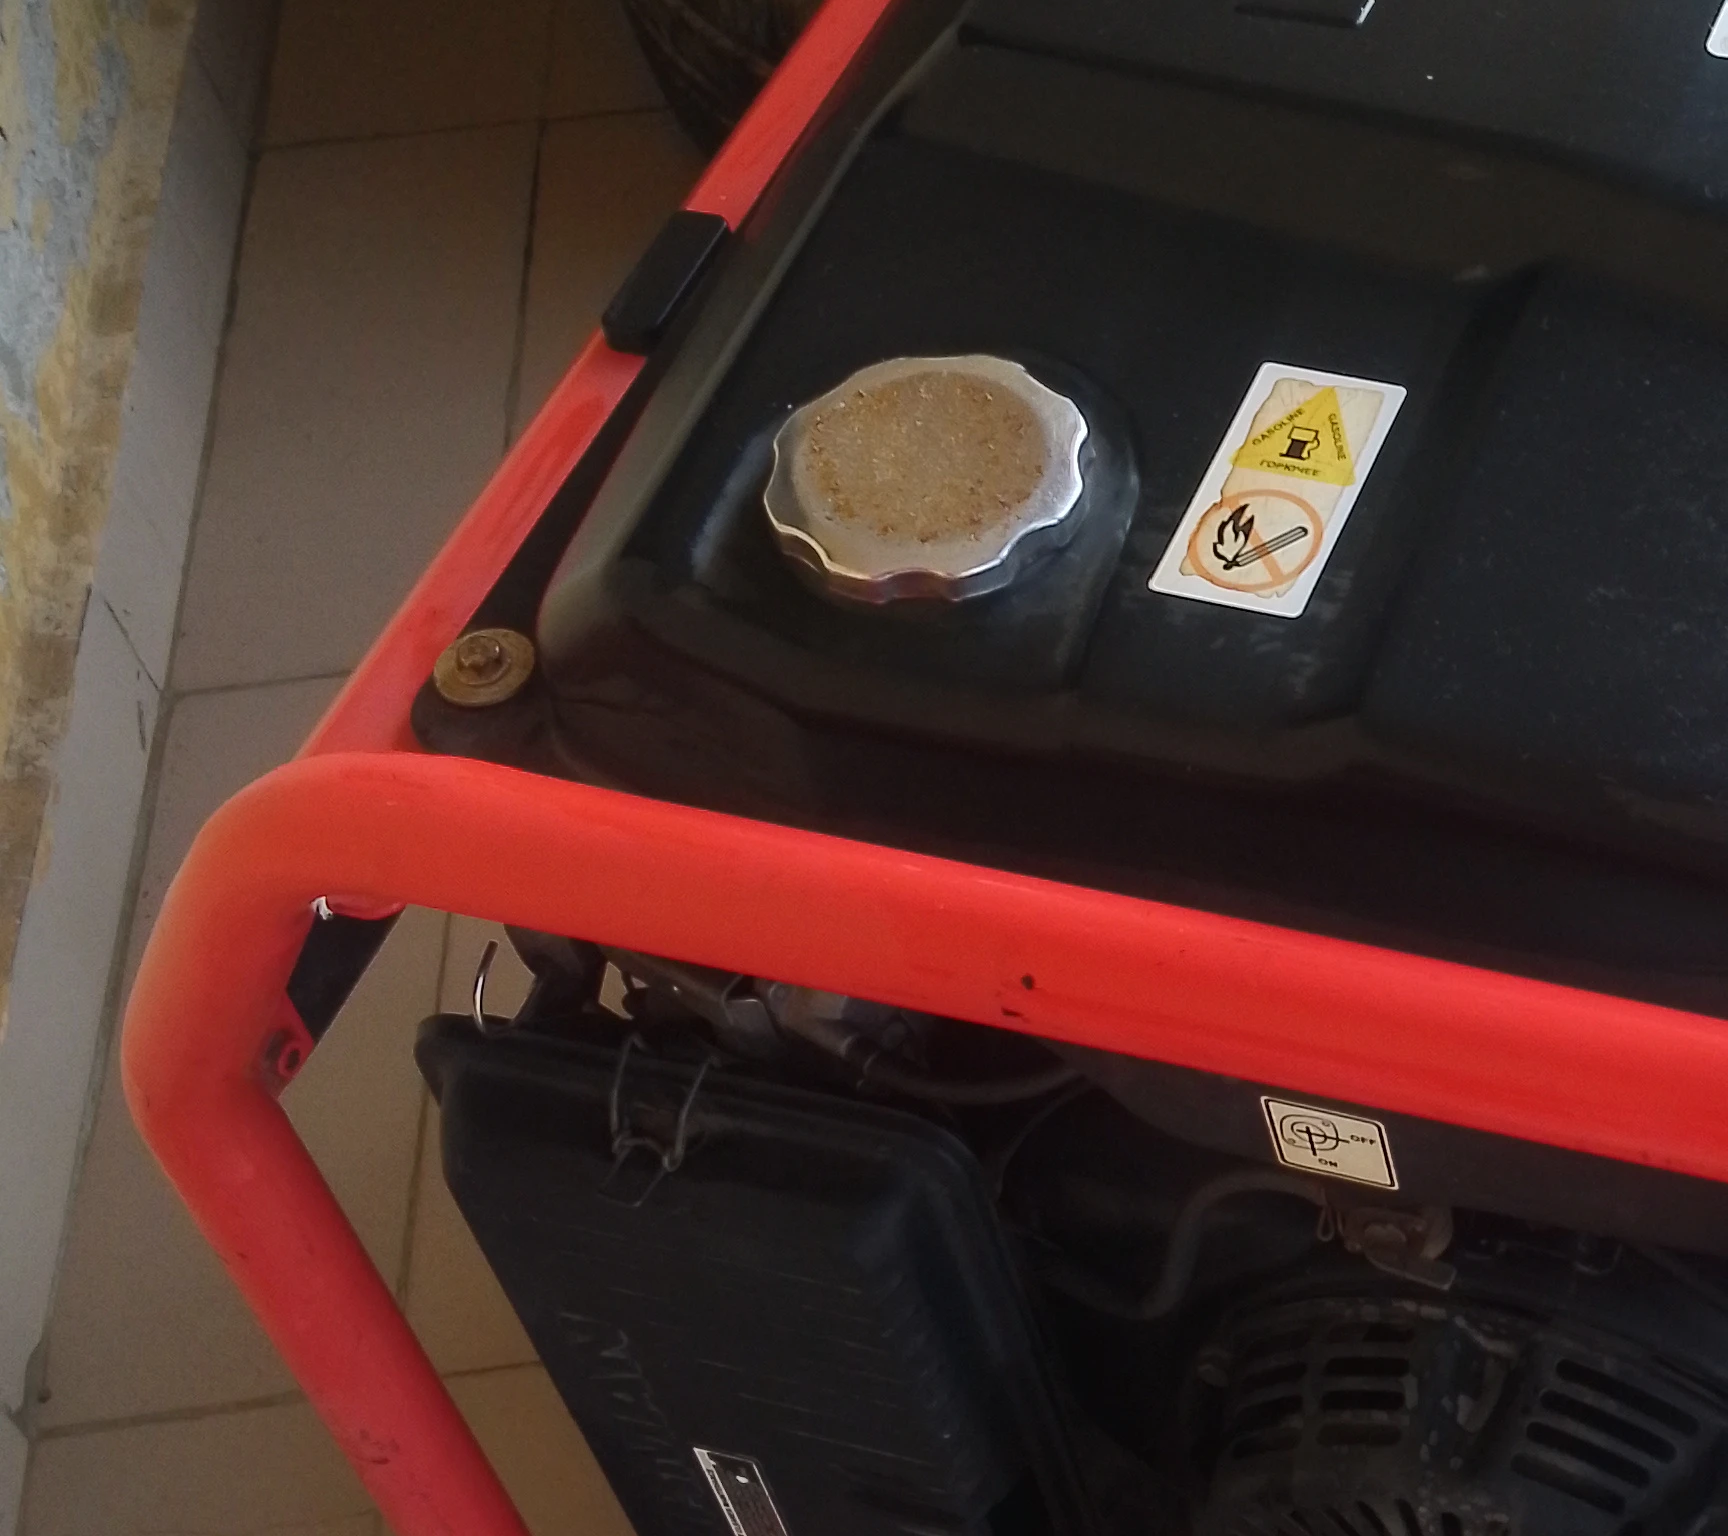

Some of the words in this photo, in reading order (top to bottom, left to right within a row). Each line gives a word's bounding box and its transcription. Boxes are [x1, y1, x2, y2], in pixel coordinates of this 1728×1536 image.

[1252, 408, 1304, 447] GASOLINE
[1328, 412, 1347, 462] GASOLINE
[1350, 1134, 1376, 1145] OFF
[1318, 1158, 1338, 1168] ON
